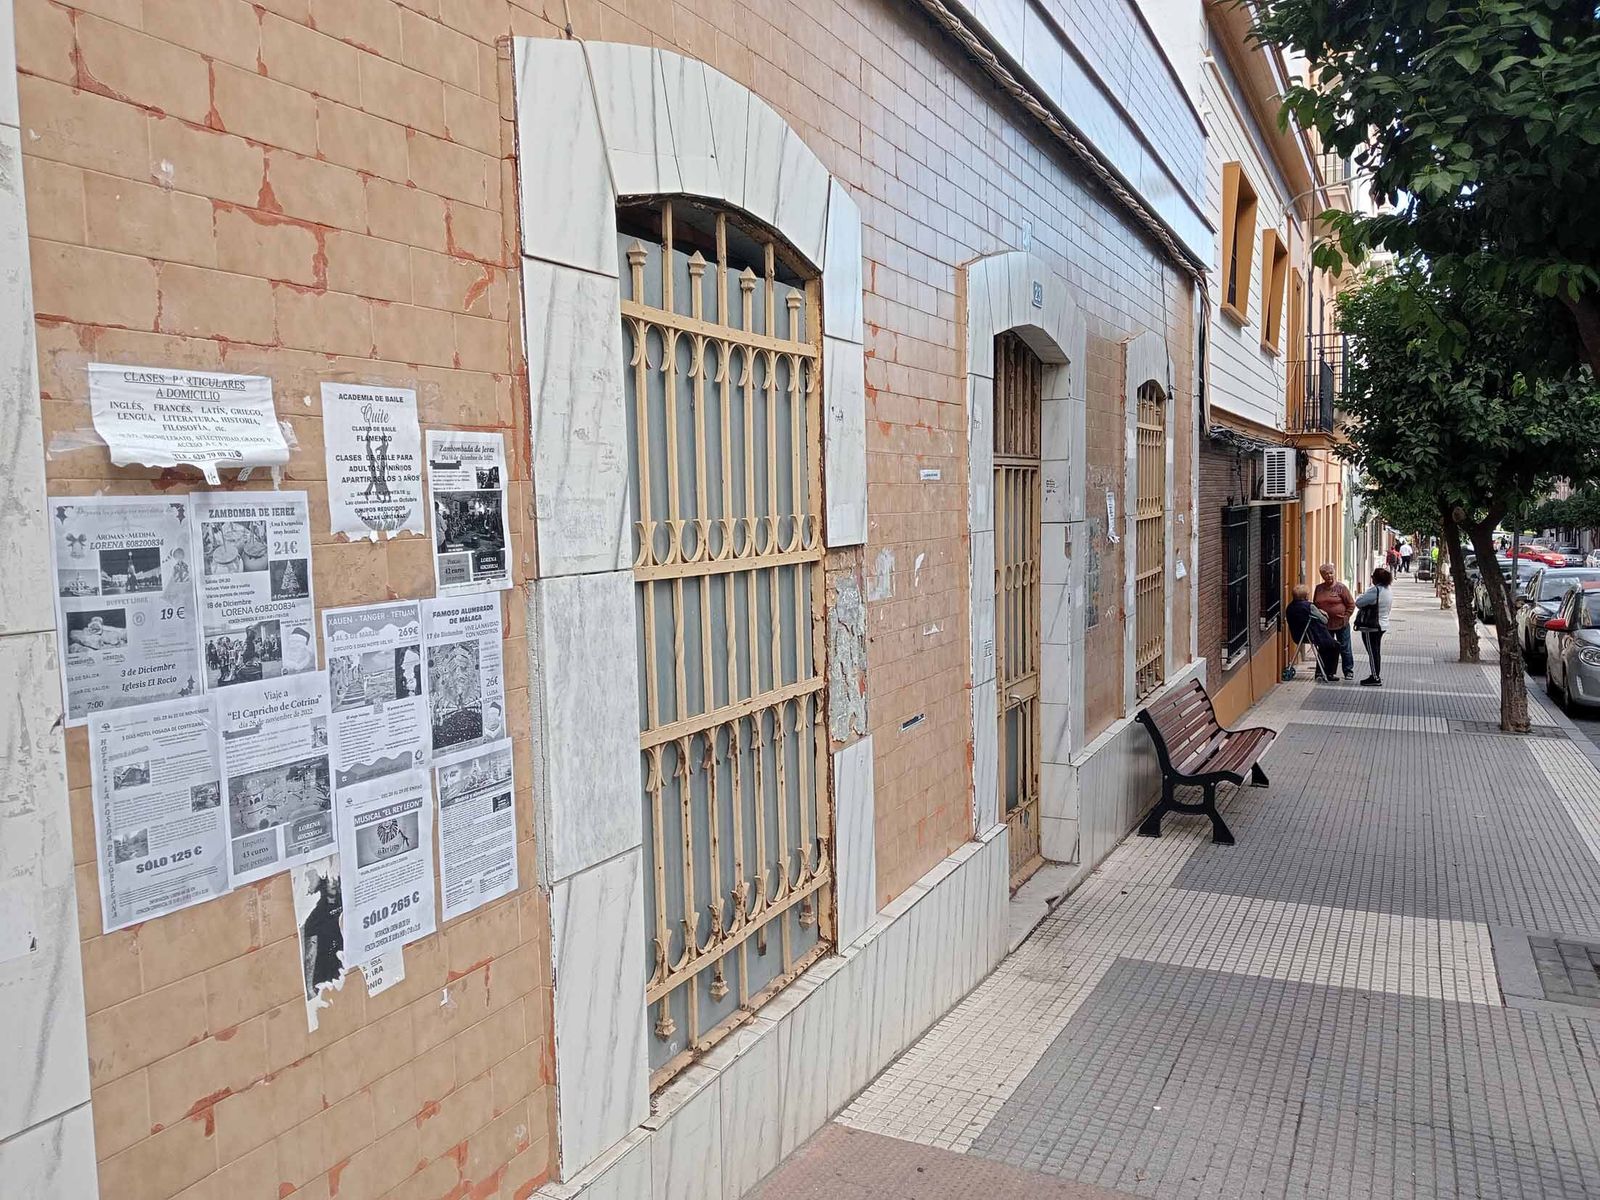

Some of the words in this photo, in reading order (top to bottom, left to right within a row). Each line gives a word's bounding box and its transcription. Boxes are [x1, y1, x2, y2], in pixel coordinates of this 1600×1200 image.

[123, 372, 165, 384] CLASES
[156, 388, 164, 398] A
[166, 388, 220, 400] DOMICILIO
[338, 393, 373, 402] ACADEMIA
[385, 395, 404, 403] BAILE
[110, 400, 145, 411] INGLÉS,
[153, 403, 193, 413] FRANCÉS,
[201, 405, 228, 415] LATÍN,
[230, 408, 263, 416] GRIEGO,
[117, 412, 156, 422] LENGUA,
[221, 417, 261, 425] HISTORIA,
[474, 445, 481, 453] de
[403, 473, 420, 482] AÑOS
[208, 508, 257, 518] ZAMBOMBA
[258, 508, 270, 517] DE
[89, 539, 124, 550] LORENA
[214, 600, 222, 608] de
[222, 599, 252, 608] Diciembre
[221, 606, 254, 617] LORENA
[254, 601, 296, 613] 608200834
[160, 608, 174, 620] 19
[176, 606, 186, 620] €
[328, 615, 353, 626] XAUEN
[360, 612, 385, 622] TANGER
[391, 608, 415, 618] TETUAN
[432, 609, 460, 619] FAMOSO
[461, 604, 494, 615] ALUMBRADO
[460, 614, 482, 623] MÁLAGA
[398, 626, 419, 638] 269€
[121, 669, 126, 677] 3
[127, 668, 137, 677] de
[138, 662, 176, 675] Diciembre
[264, 690, 282, 701] Viaje
[284, 690, 289, 698] a
[87, 700, 104, 709] 7:00
[242, 704, 279, 719] Capricho
[280, 702, 289, 711] de
[354, 813, 381, 825] MUSICAL
[392, 805, 403, 814] REY
[170, 848, 191, 864] 125
[193, 845, 202, 856] €
[362, 906, 389, 930] SÓLO
[390, 895, 411, 916] 265
[412, 890, 420, 904] €
